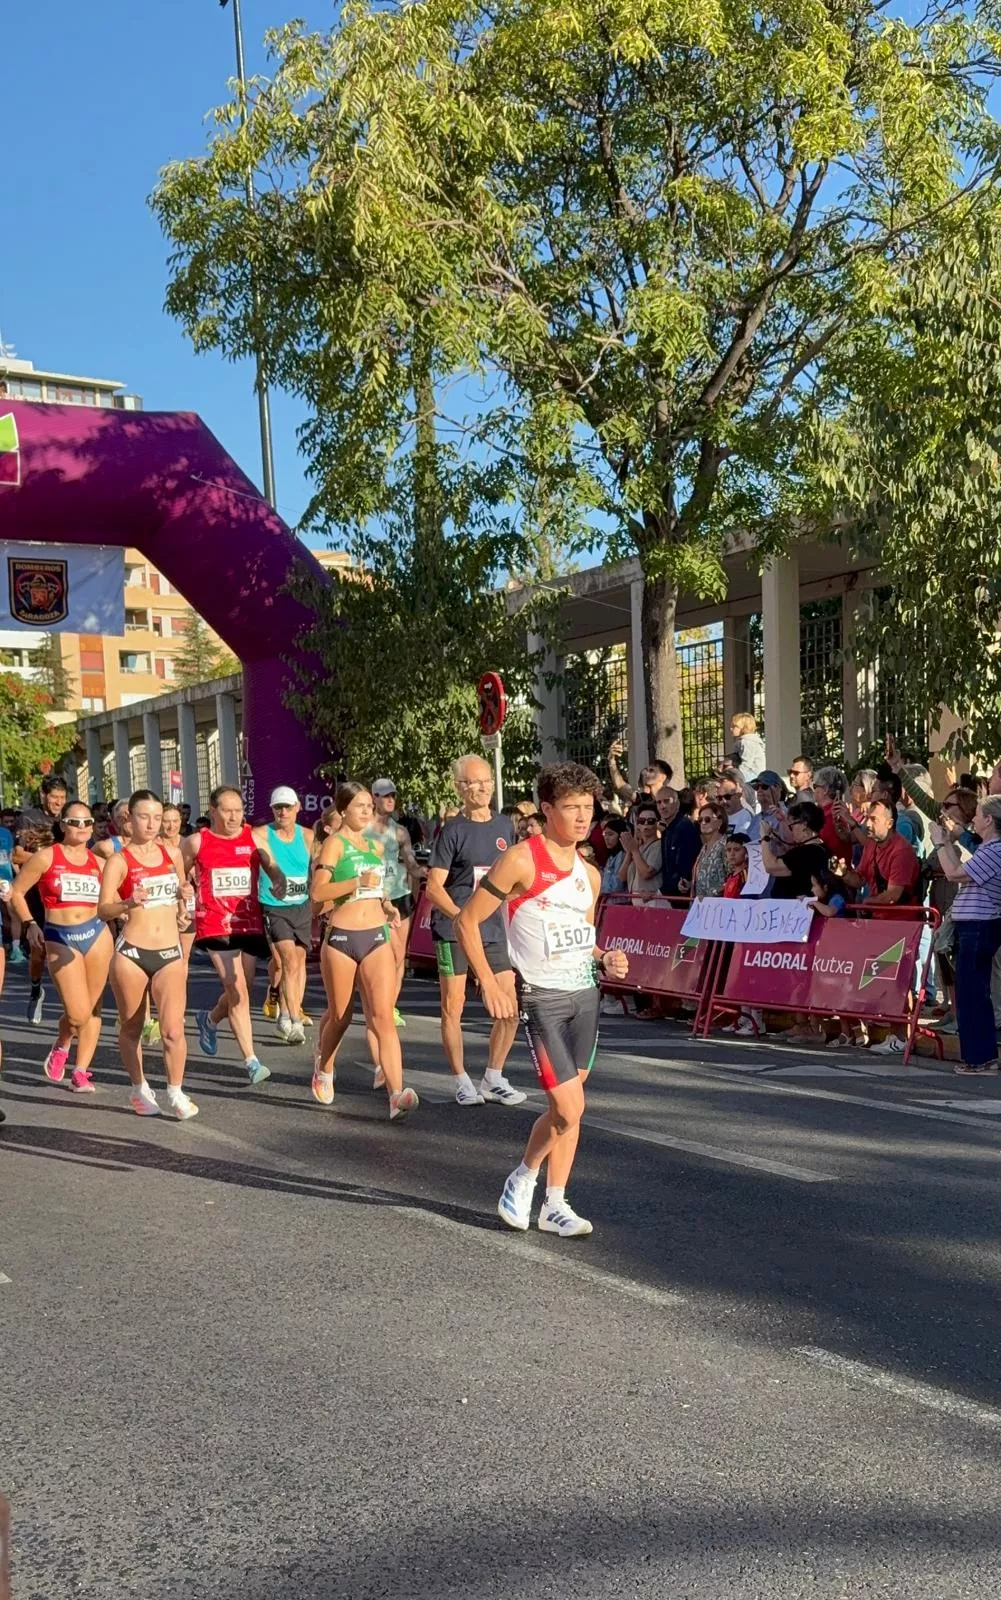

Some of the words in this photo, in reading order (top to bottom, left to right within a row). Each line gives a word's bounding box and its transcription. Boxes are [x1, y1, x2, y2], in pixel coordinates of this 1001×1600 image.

[66, 880, 97, 893] 1582
[216, 875, 248, 887] 1508
[553, 927, 591, 948] 1507
[605, 936, 644, 955] LABORAL
[645, 941, 671, 958] kutxa
[743, 950, 808, 971] LABORAL
[811, 955, 854, 975] kutxa
